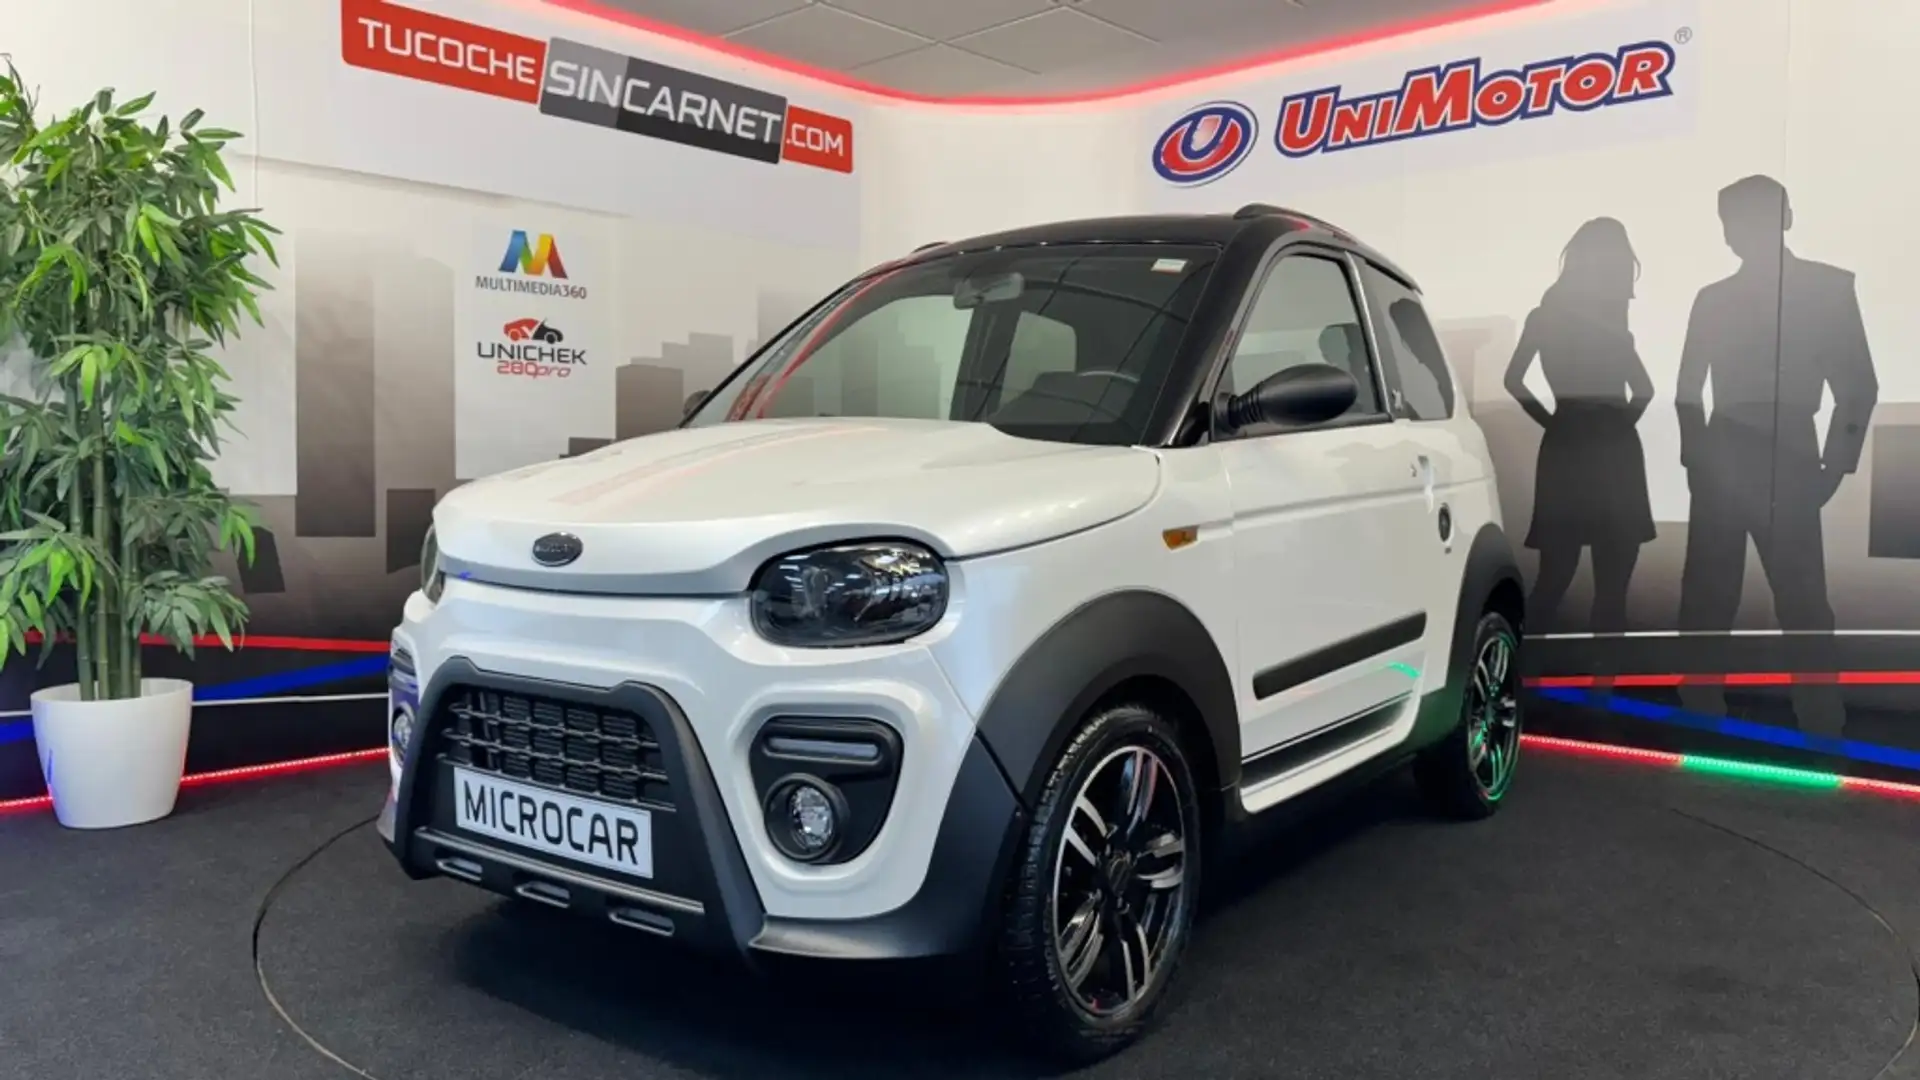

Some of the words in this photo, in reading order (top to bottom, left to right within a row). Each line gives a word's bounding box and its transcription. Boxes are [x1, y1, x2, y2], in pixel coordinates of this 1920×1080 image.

[475, 275, 588, 300] MULTIMEDIA360
[477, 341, 588, 365] UNICHEK
[464, 780, 639, 866] MICROCAR
